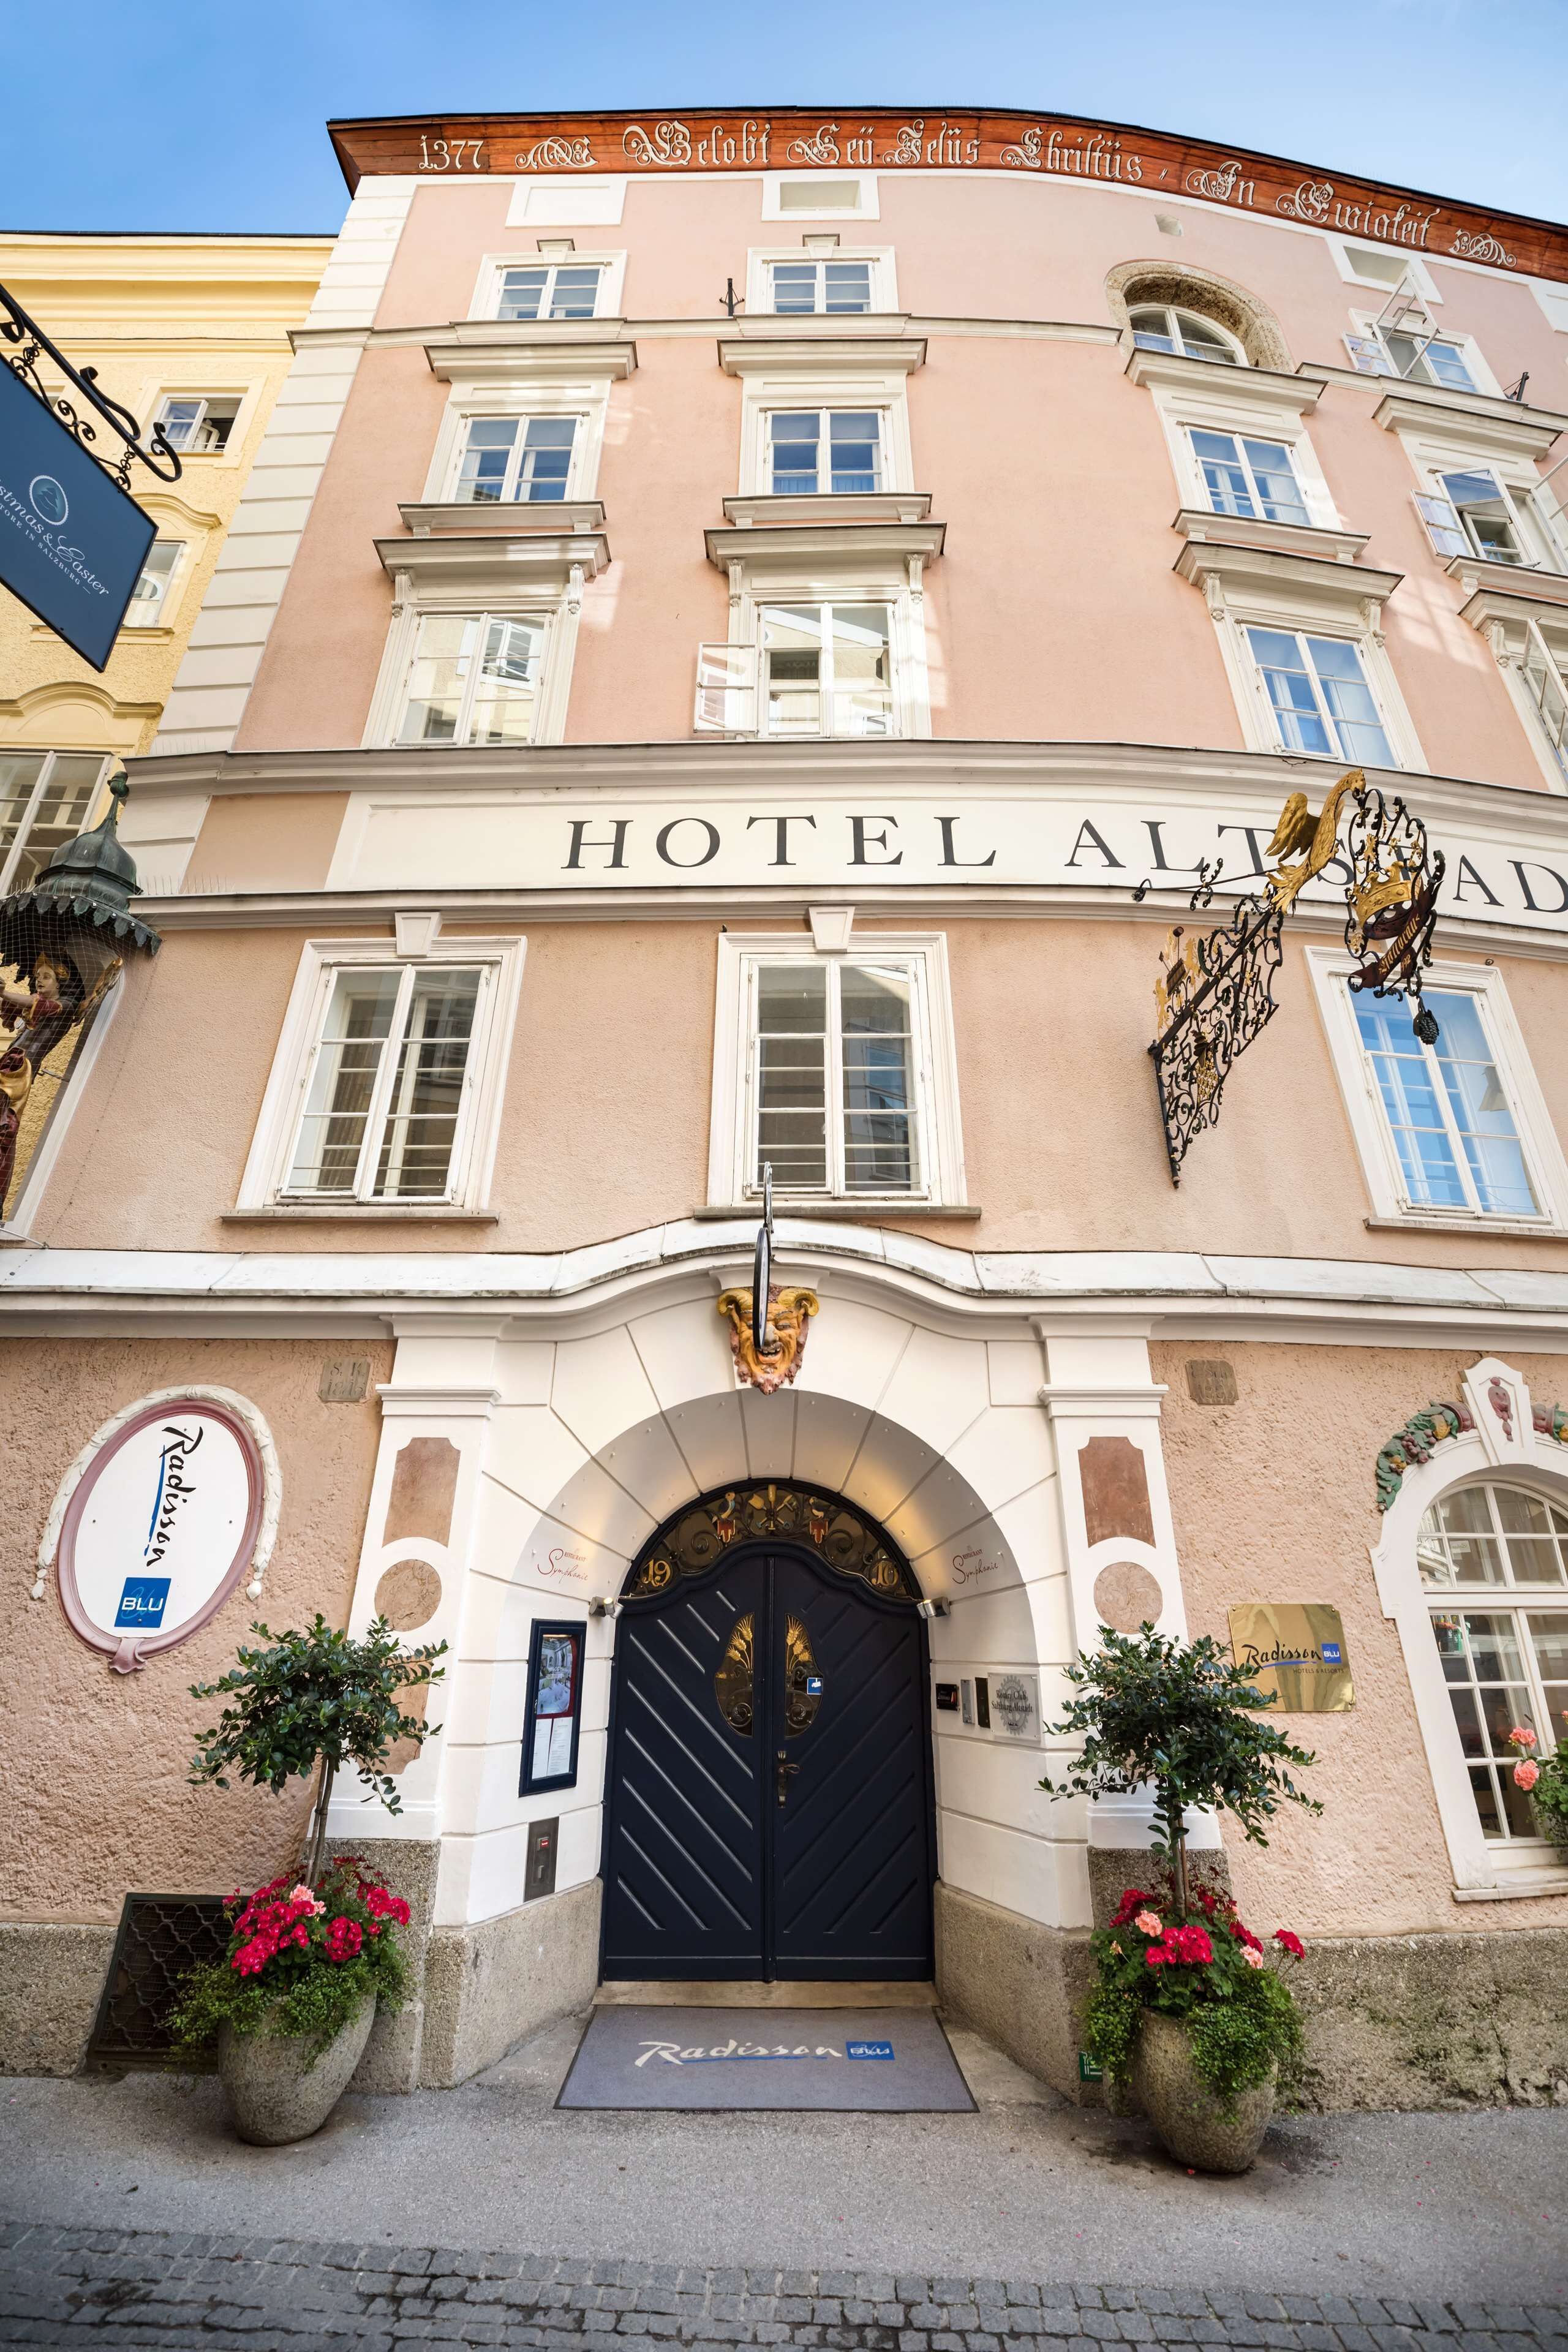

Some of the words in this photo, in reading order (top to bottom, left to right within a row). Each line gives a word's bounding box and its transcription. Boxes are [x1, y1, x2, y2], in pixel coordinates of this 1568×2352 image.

[419, 134, 484, 170] 1377
[25, 529, 36, 541] IN
[37, 542, 81, 586] SALZBURG
[57, 535, 110, 595] Easter
[560, 815, 997, 869] HOTEL
[146, 1426, 204, 1567] Radisson
[642, 1558, 671, 1587] 19
[871, 1560, 899, 1586] 10
[121, 1597, 164, 1611] BLU
[1242, 1640, 1322, 1670] Radisson
[991, 1700, 1013, 1713] Salzburg
[1014, 1702, 1034, 1713] Altstadt
[996, 1690, 1012, 1700] Rotary
[1013, 1690, 1027, 1700] Club
[635, 2040, 843, 2067] Radisson
